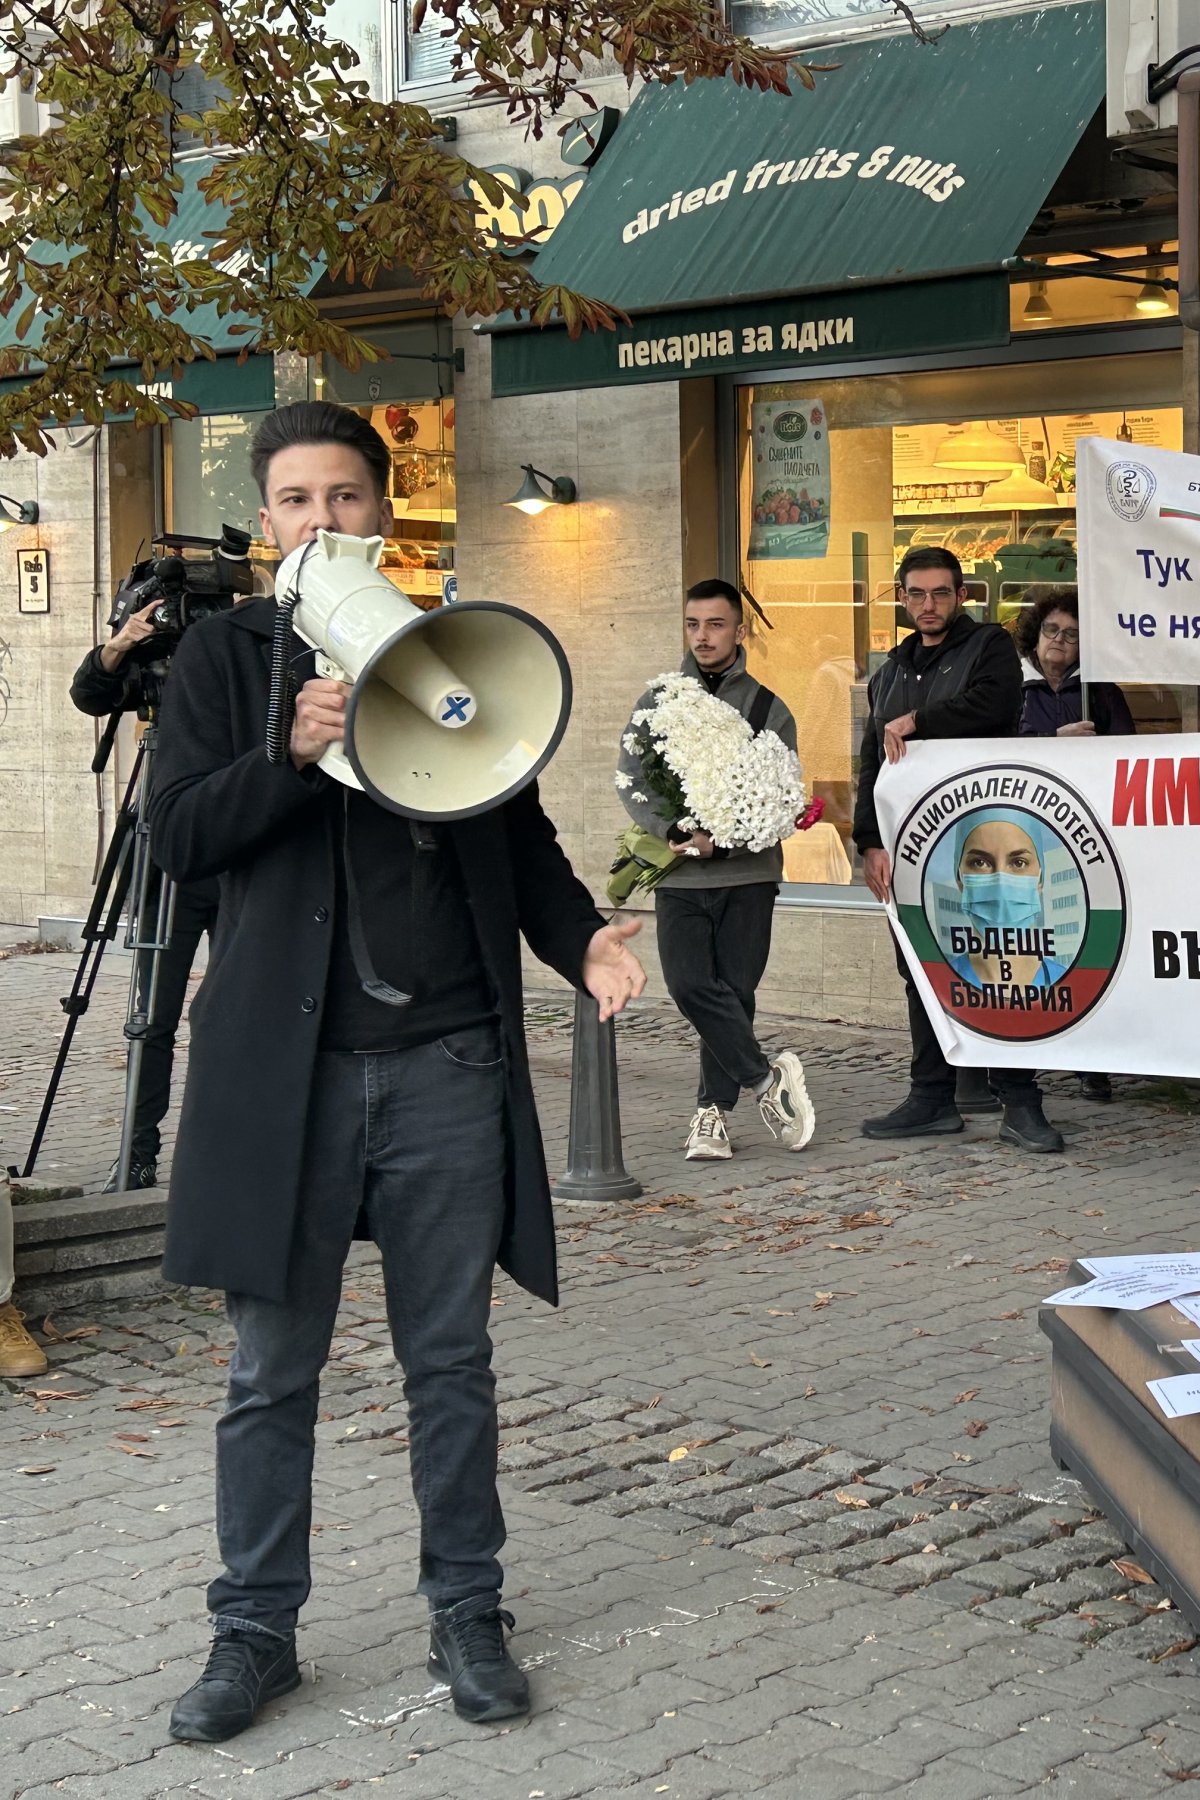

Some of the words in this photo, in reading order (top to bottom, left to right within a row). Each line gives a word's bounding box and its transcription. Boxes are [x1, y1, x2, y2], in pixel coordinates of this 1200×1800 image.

[622, 169, 737, 244] dried
[742, 147, 860, 195] fruits
[858, 145, 895, 179] &
[886, 152, 966, 203] nuts
[618, 328, 734, 369] пекарна
[741, 324, 773, 353] за
[781, 316, 854, 354] ядки
[30, 576, 38, 593] 5
[1136, 549, 1193, 588] Тук
[1118, 613, 1157, 637] че
[900, 777, 1028, 866] НАЦИОНАЛЕН
[1030, 784, 1105, 866] ПРОТЕСТ
[950, 926, 1056, 960] БЪДЕЩЕ
[1000, 960, 1013, 981] В
[949, 980, 1073, 1012] БЪЛГАРИЯ
